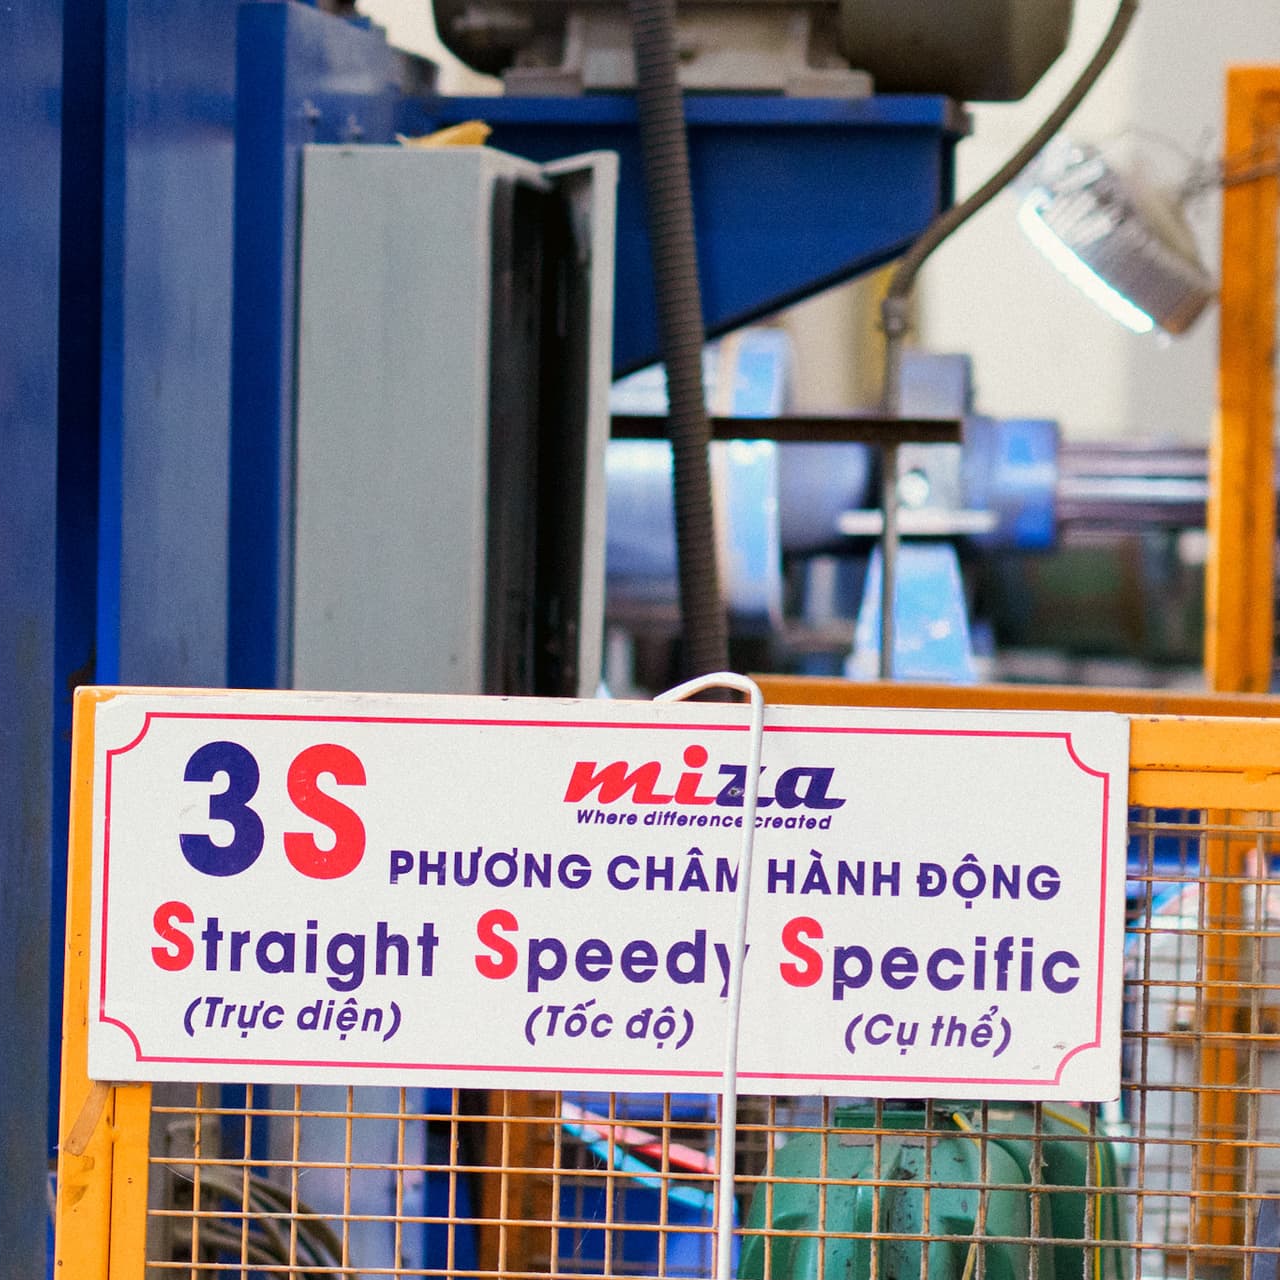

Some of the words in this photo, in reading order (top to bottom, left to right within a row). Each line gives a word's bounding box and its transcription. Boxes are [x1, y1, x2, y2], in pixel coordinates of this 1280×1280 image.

[563, 745, 847, 810] miza
[178, 740, 368, 880] 3S
[576, 809, 638, 826] Where
[643, 811, 744, 828] difference
[753, 815, 833, 830] created
[389, 846, 592, 890] PHƯƠNG
[606, 846, 740, 894] CHÂM
[767, 848, 901, 897] HÀNH
[916, 853, 1062, 909] ĐỘNG
[151, 900, 439, 993] Straight
[474, 908, 751, 998] Speedy
[779, 915, 1081, 1001] Specific
[183, 997, 285, 1038] (Trực
[297, 998, 402, 1043] diện)
[524, 998, 614, 1047] (Tốc
[625, 1004, 695, 1050] độ)
[844, 1012, 919, 1056] (Cụ
[931, 1005, 1012, 1058] thể)
